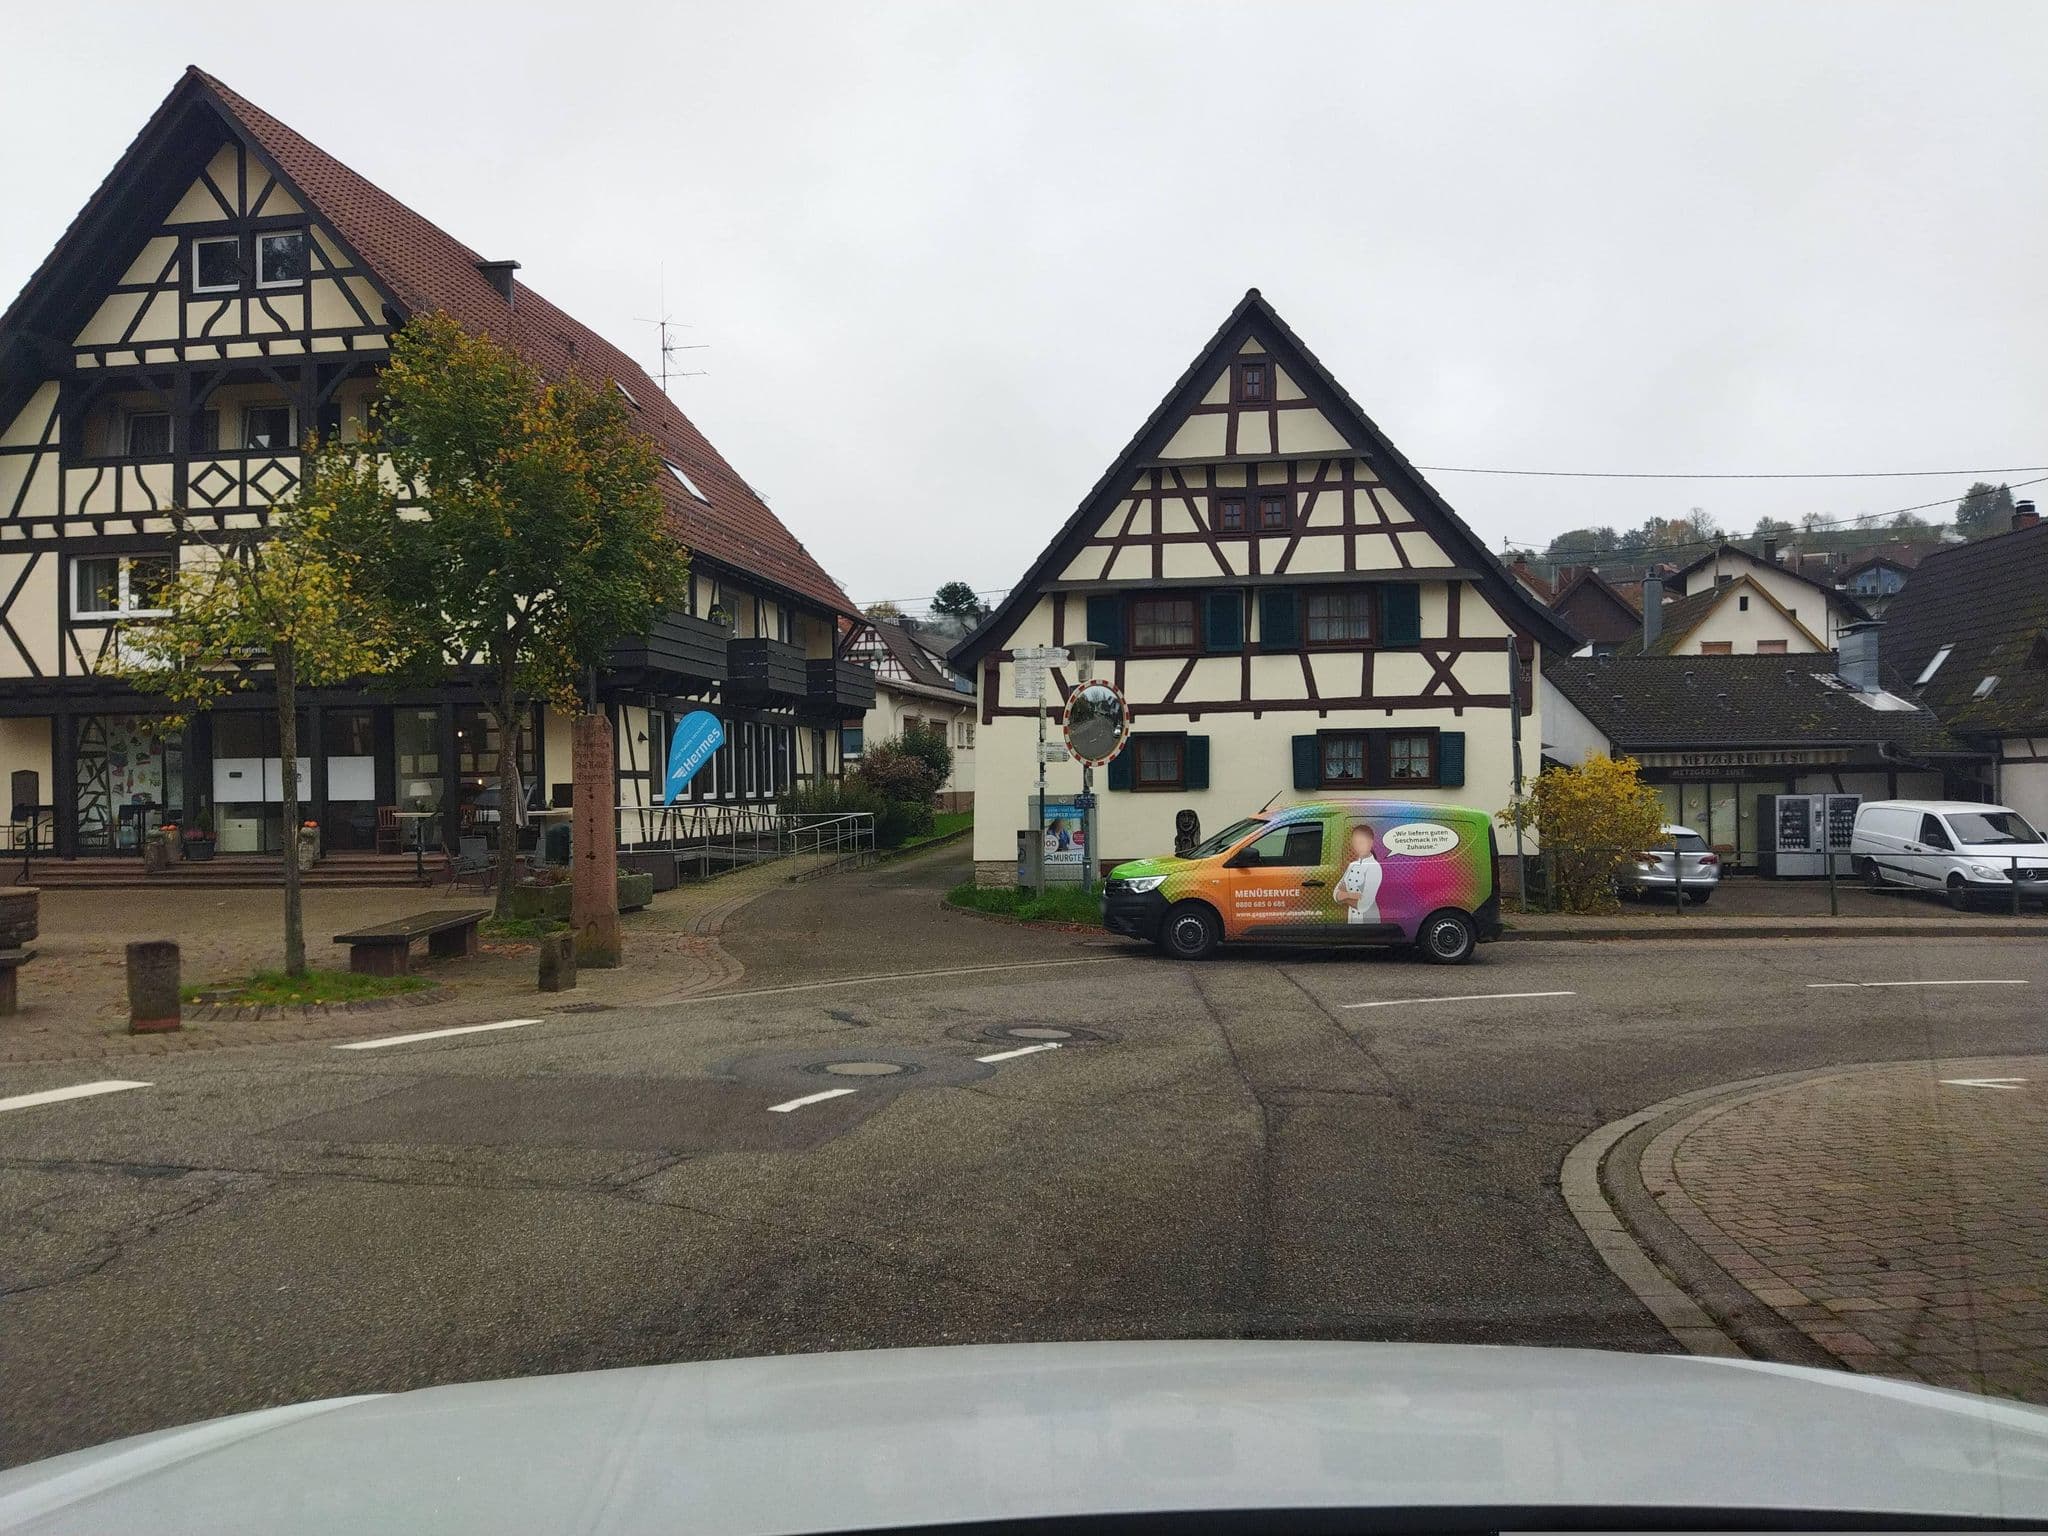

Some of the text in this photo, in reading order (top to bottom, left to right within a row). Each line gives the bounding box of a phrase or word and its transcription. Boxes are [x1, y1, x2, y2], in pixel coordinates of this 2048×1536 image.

[683, 728, 720, 771] Hermes
[1430, 830, 1449, 838] guten
[1054, 853, 1083, 862] MURGTE
[1235, 888, 1300, 898] MENÜSERVICE
